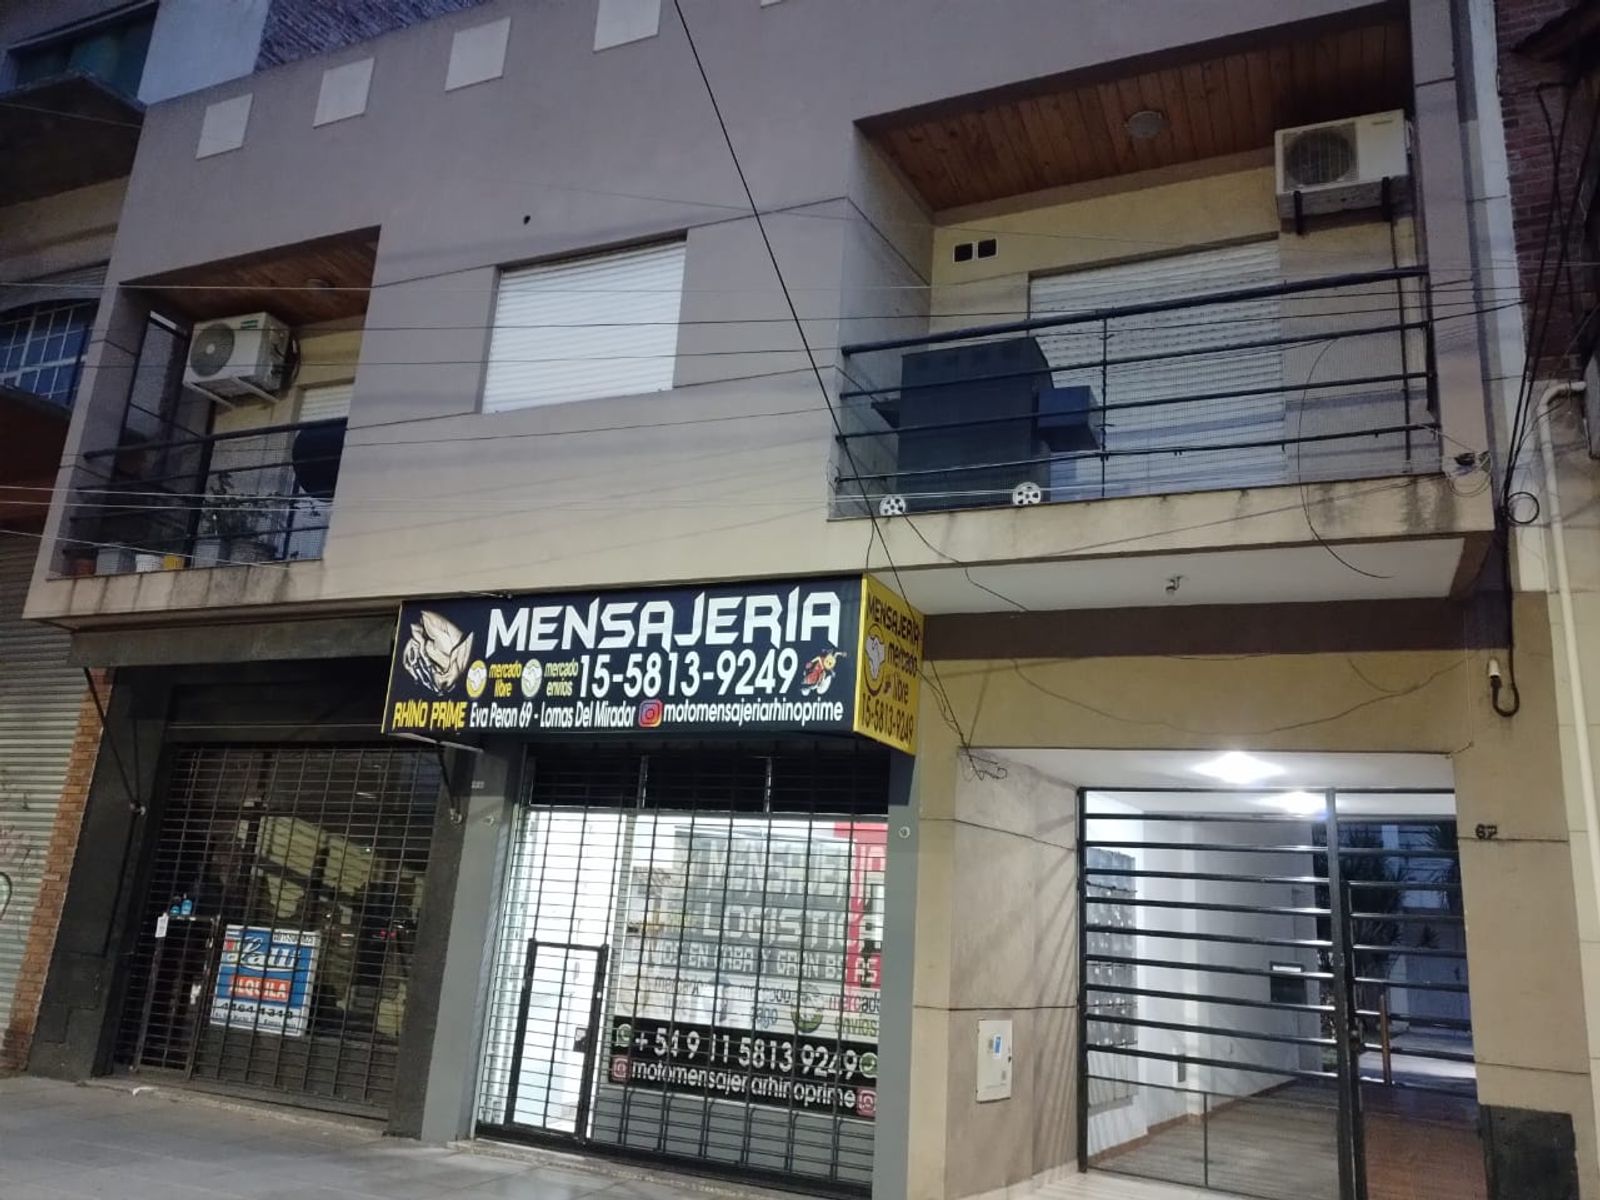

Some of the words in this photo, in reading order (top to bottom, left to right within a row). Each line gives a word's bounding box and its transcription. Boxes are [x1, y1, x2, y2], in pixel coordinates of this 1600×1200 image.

[485, 586, 841, 658] MENSAJERIA
[579, 647, 799, 699] 15-5813-9249
[392, 698, 428, 730] RHINO
[430, 699, 468, 731] PRIME
[469, 701, 489, 727] Eva
[519, 701, 533, 728] 69
[540, 700, 573, 728] Lomas
[575, 700, 593, 728] Del
[594, 699, 636, 727] Mirador
[663, 697, 844, 727] motomensajeriarhinoprime
[738, 1037, 793, 1072] 5813
[631, 1060, 856, 1109] motomensajerarhinoprime
